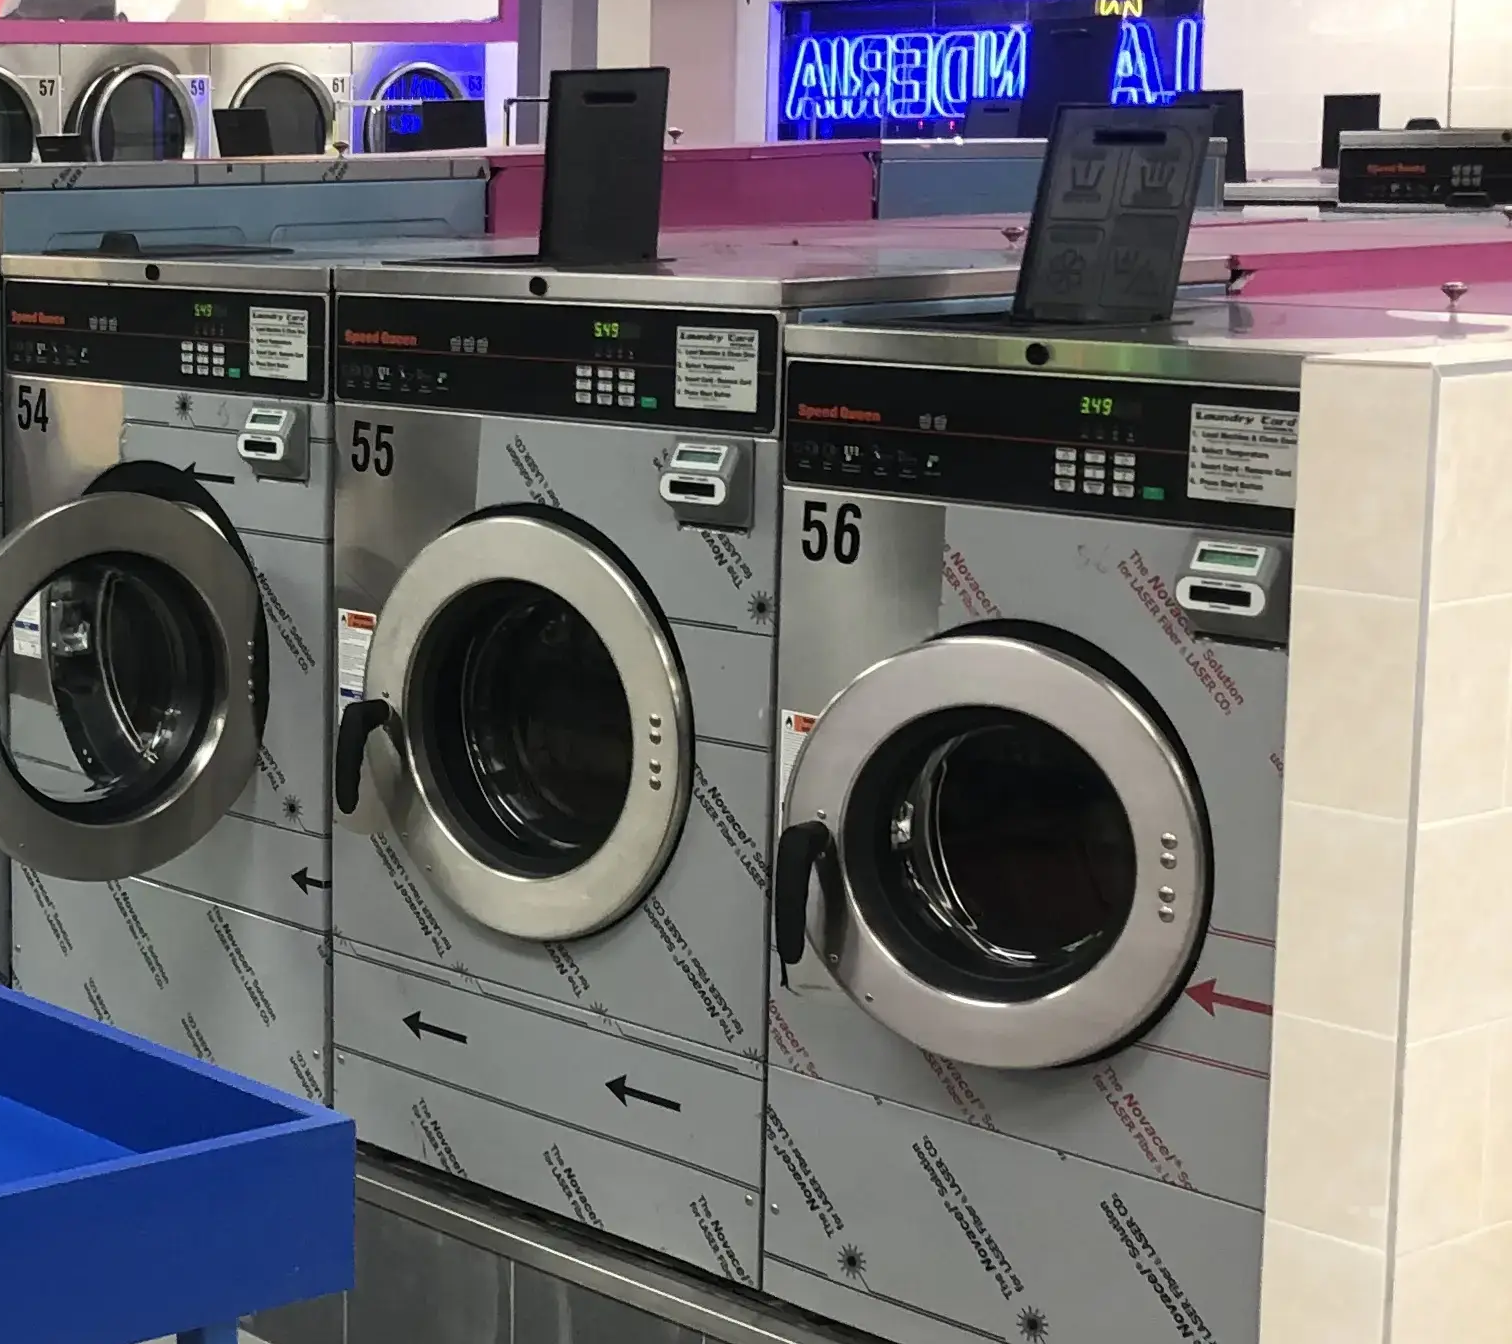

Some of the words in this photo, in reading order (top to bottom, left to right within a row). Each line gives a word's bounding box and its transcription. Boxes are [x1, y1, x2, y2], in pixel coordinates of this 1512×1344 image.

[39, 79, 55, 97] 57
[190, 79, 206, 97] 59
[332, 77, 346, 93] 61
[18, 385, 49, 432] 54
[799, 403, 838, 419] Speed
[1195, 411, 1255, 425] Laundry
[1261, 415, 1297, 426] Card
[351, 420, 395, 476] 55
[801, 500, 862, 565] 56
[1116, 560, 1132, 579] for
[1130, 578, 1161, 618] LASER
[1157, 614, 1182, 646] Fiber
[1185, 651, 1216, 694] LASER
[1129, 549, 1148, 576] The
[1202, 649, 1245, 706] Solution
[912, 1142, 948, 1197] Solution
[935, 1157, 962, 1197] LASER
[1100, 1200, 1140, 1259] Solution
[1126, 1216, 1156, 1258] LASER
[985, 1234, 1012, 1274] LASER
[1181, 1298, 1213, 1341] LASER
